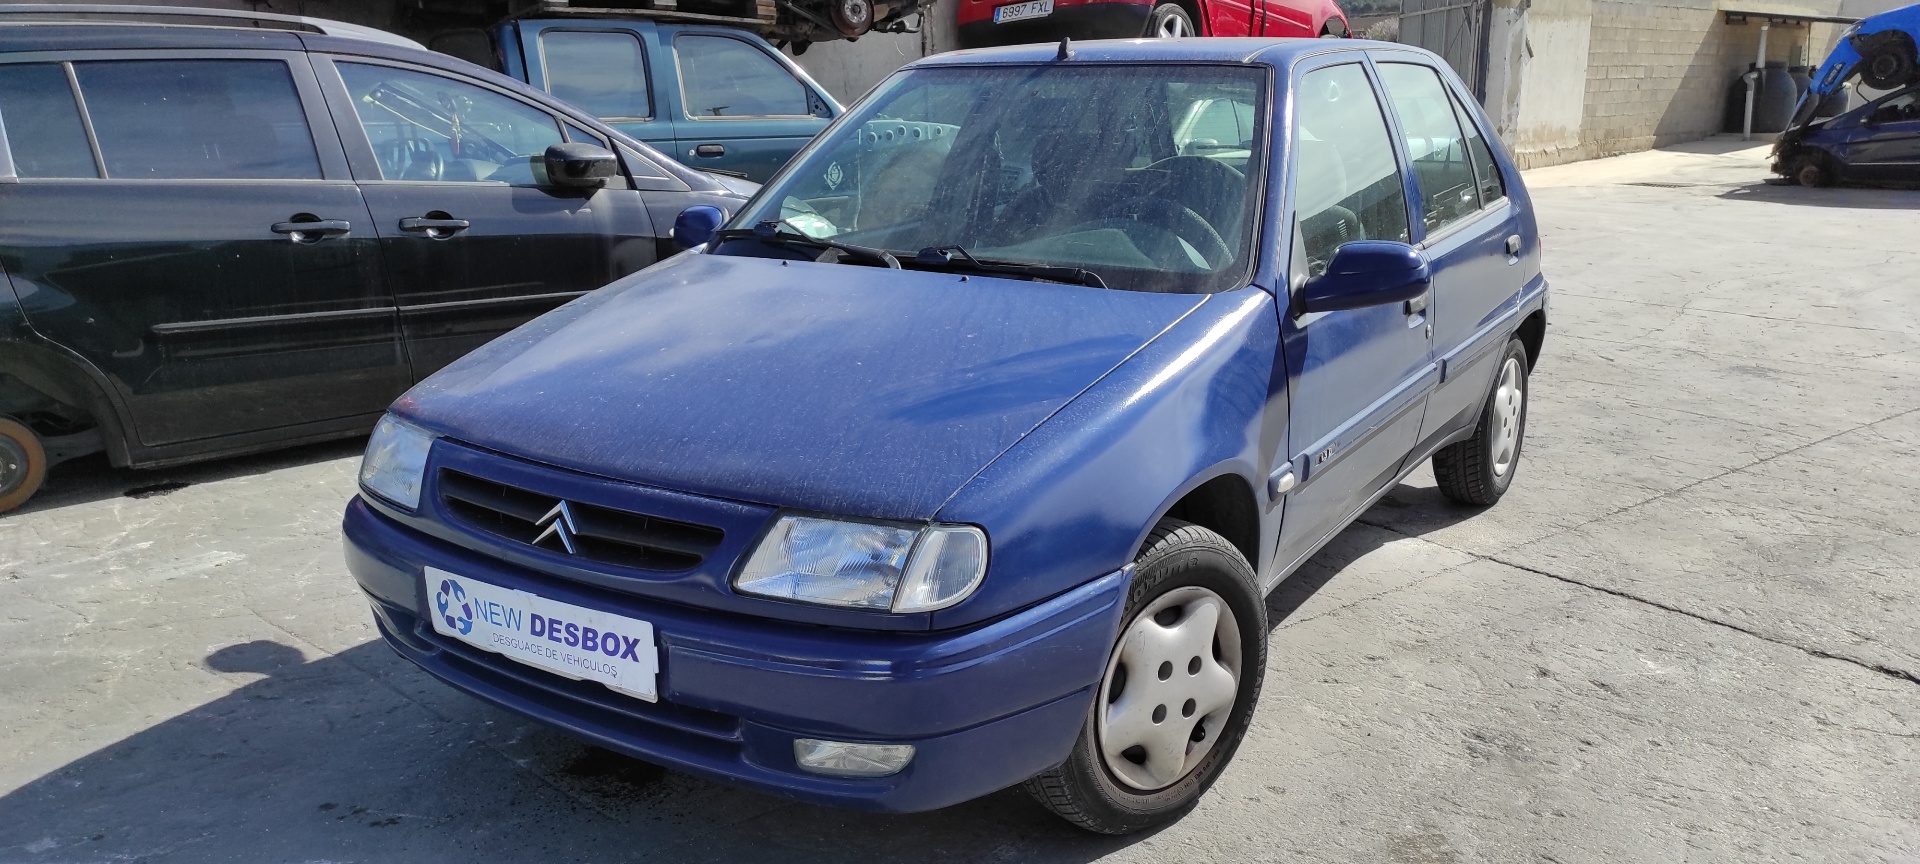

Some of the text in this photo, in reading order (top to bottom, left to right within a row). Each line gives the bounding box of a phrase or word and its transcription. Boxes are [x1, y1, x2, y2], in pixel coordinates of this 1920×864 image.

[1002, 1, 1049, 18] 6997 FXL
[474, 597, 641, 663] NEW DESBOX
[492, 632, 618, 678] DESGUACE DE VEHICULOS
